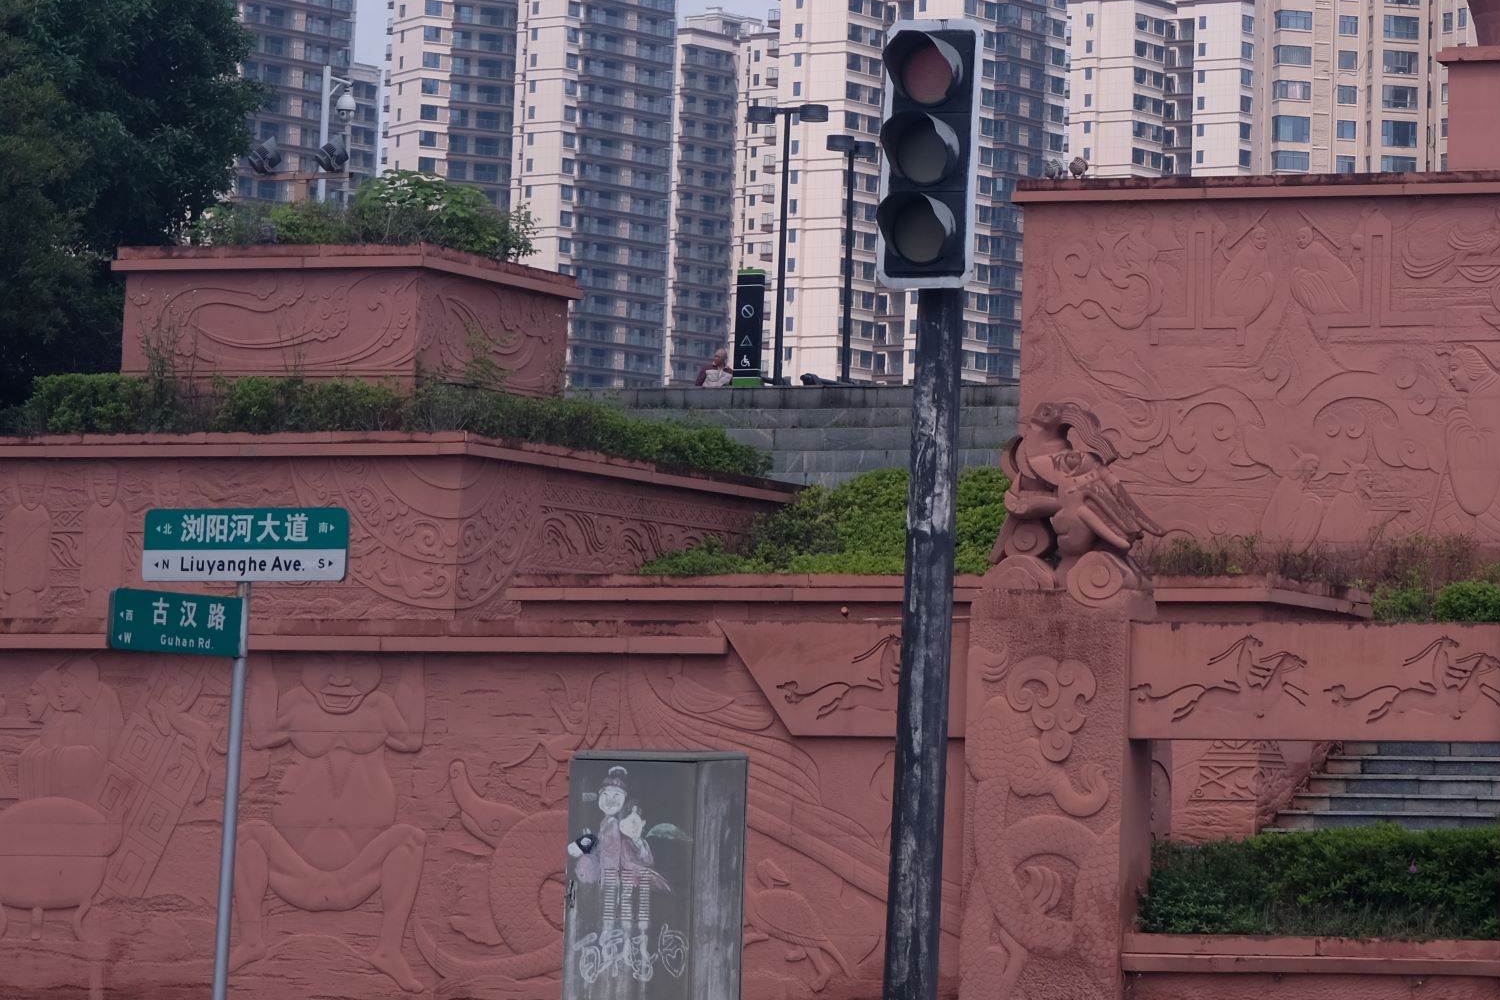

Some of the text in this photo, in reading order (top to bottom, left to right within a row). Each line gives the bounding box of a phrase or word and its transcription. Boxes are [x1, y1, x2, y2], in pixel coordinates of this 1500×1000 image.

[162, 513, 328, 543] 北 浏阳河大道 南
[162, 556, 325, 576] N Liuyanghe Ave. S
[125, 597, 226, 631] 西 古汉路
[123, 632, 214, 650] W Guhan Rd.
